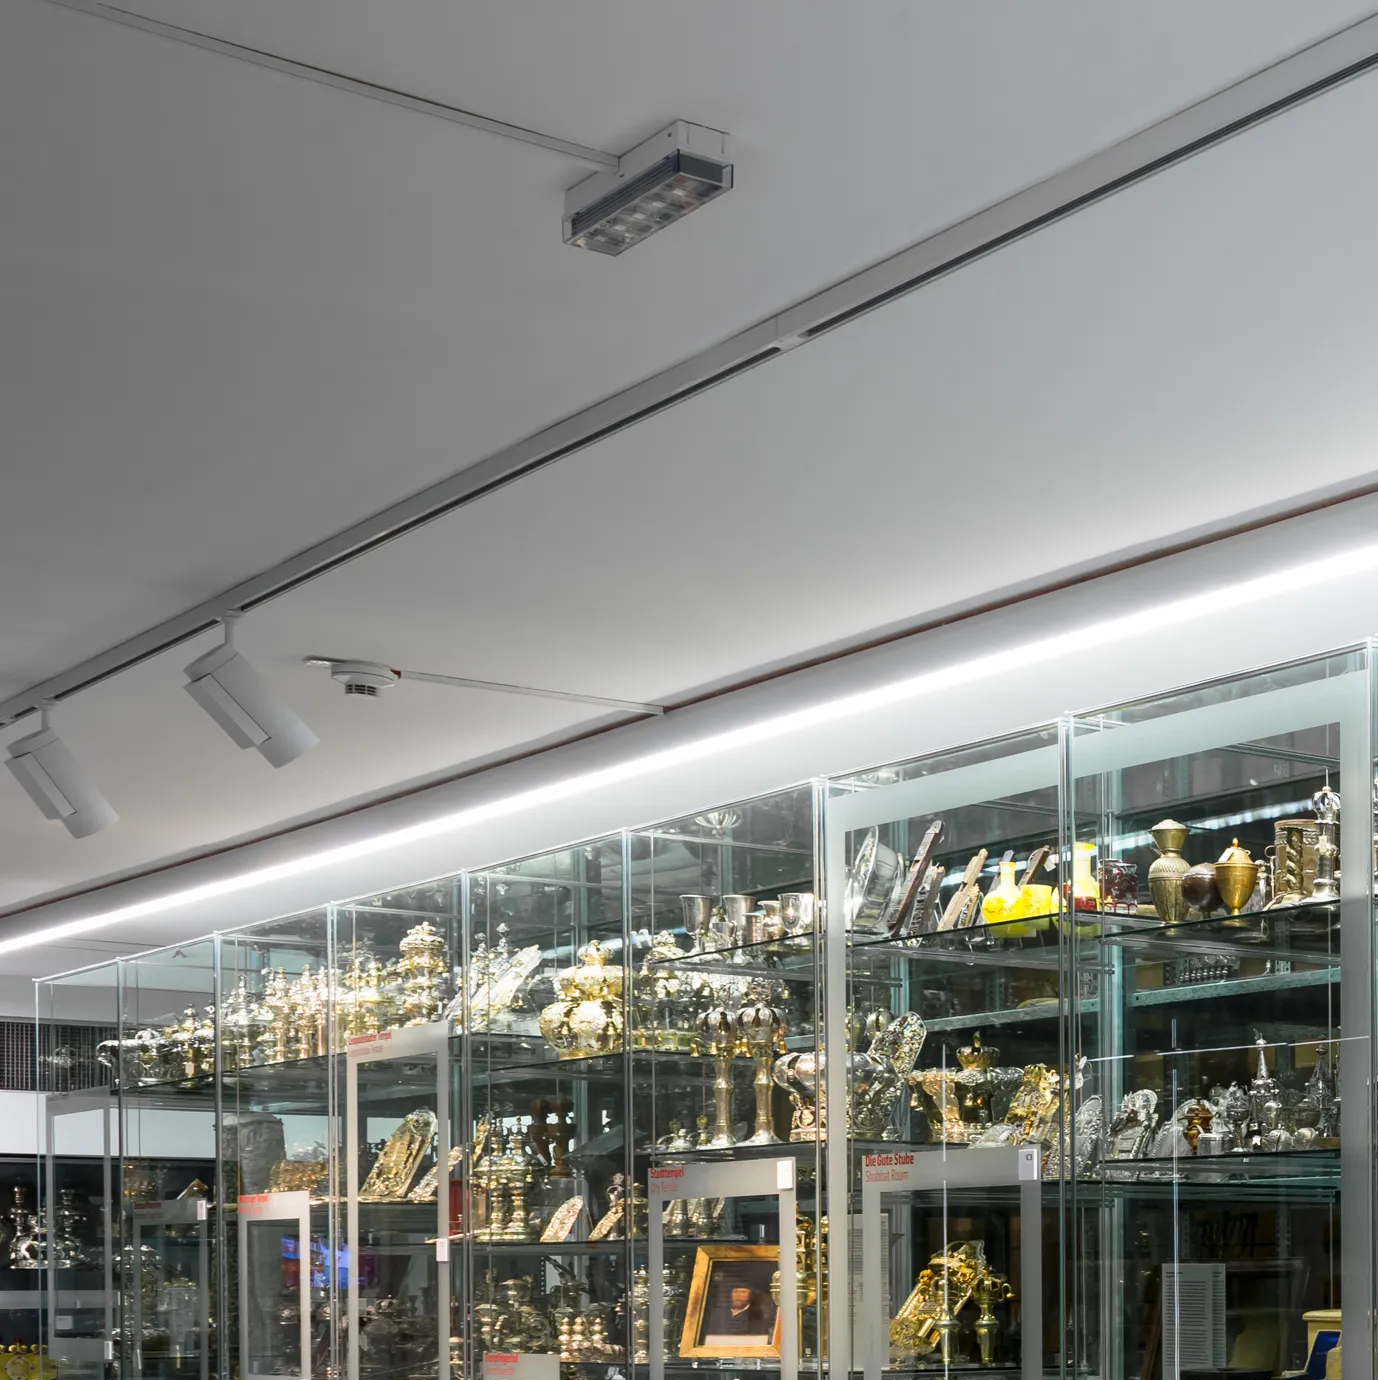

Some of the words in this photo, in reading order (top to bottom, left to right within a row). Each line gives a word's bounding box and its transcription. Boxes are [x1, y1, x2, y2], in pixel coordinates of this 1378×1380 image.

[865, 1153, 876, 1167] Die
[877, 1152, 893, 1167] Gute
[894, 1152, 915, 1166] Stube
